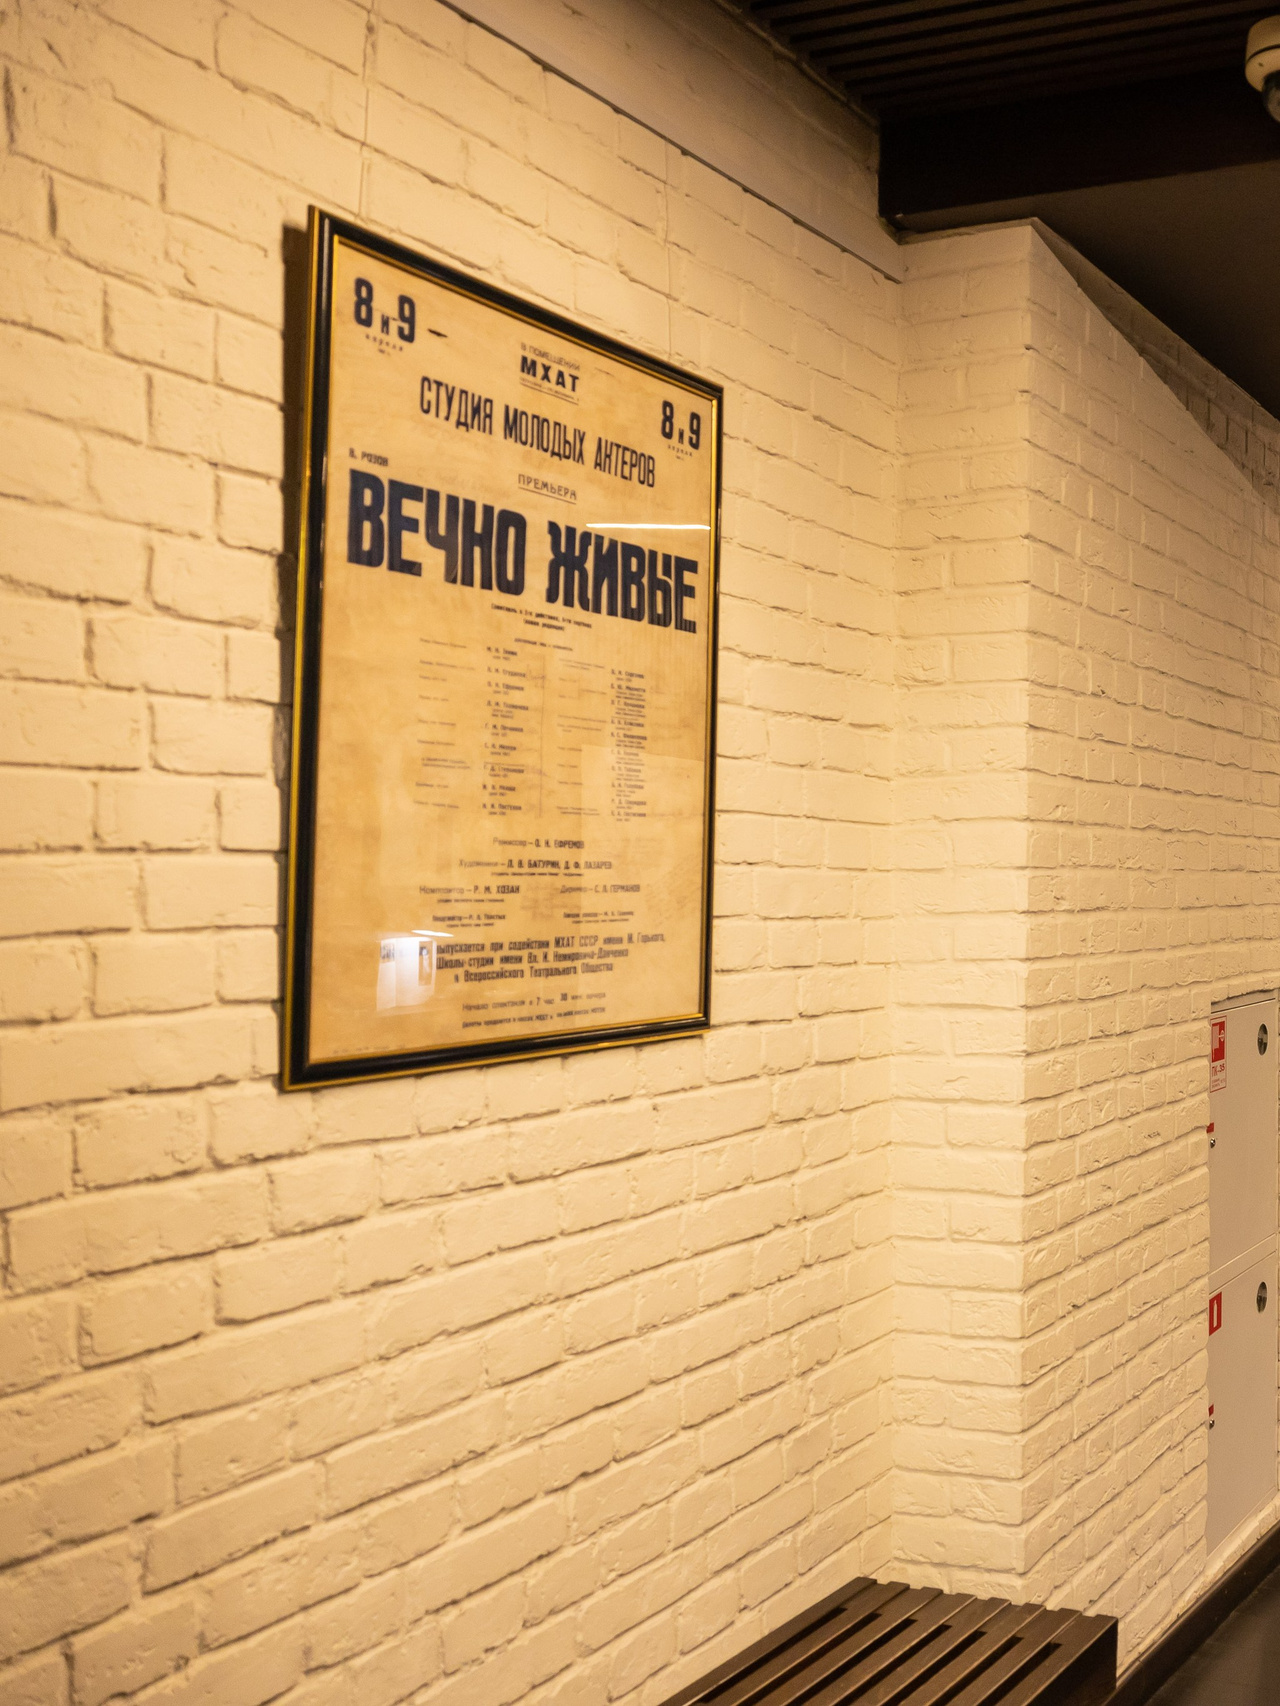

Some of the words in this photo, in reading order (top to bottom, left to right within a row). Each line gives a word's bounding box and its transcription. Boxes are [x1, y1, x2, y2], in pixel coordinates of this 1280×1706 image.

[354, 277, 373, 328] 8
[381, 314, 389, 335] и
[398, 294, 415, 343] 9
[521, 355, 579, 392] МХАТ
[420, 375, 493, 435] СТУДИЯ
[503, 404, 586, 465] МОЛОДЫХ
[594, 436, 655, 488] АКТЕРОВ
[661, 399, 674, 440] 8
[688, 411, 701, 450] 9
[518, 473, 577, 500] ПРЕМЬЕРА
[347, 468, 527, 596] ВЕЧНО
